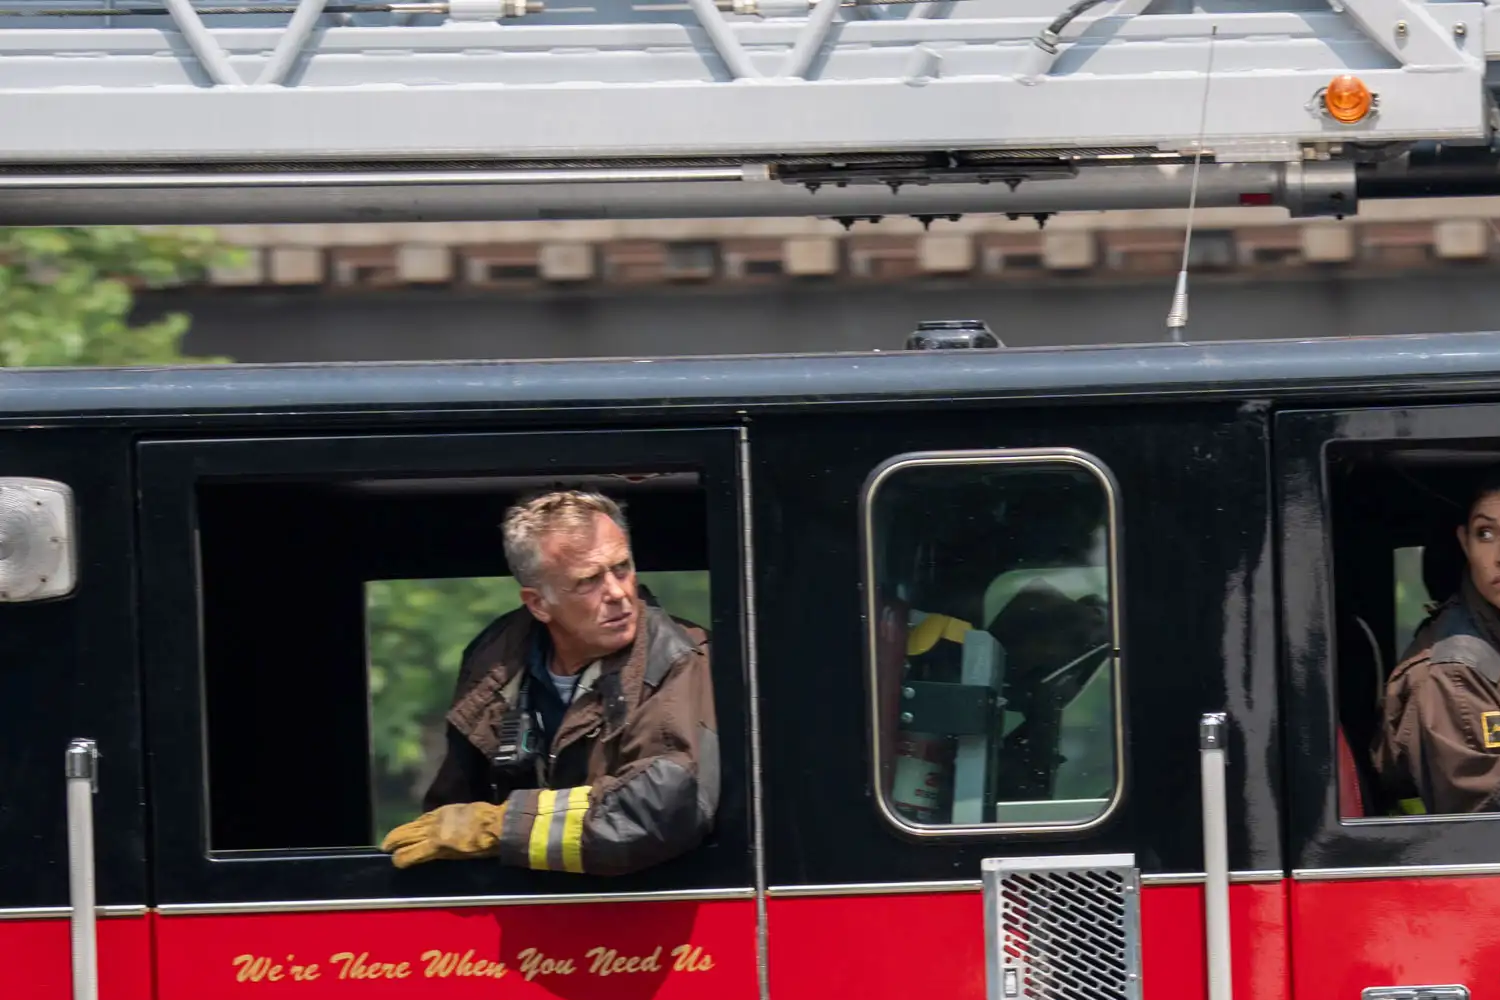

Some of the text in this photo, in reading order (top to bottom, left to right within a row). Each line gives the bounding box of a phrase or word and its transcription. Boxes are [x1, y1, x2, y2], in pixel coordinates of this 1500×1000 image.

[232, 943, 717, 983] We're There When You Need Us
